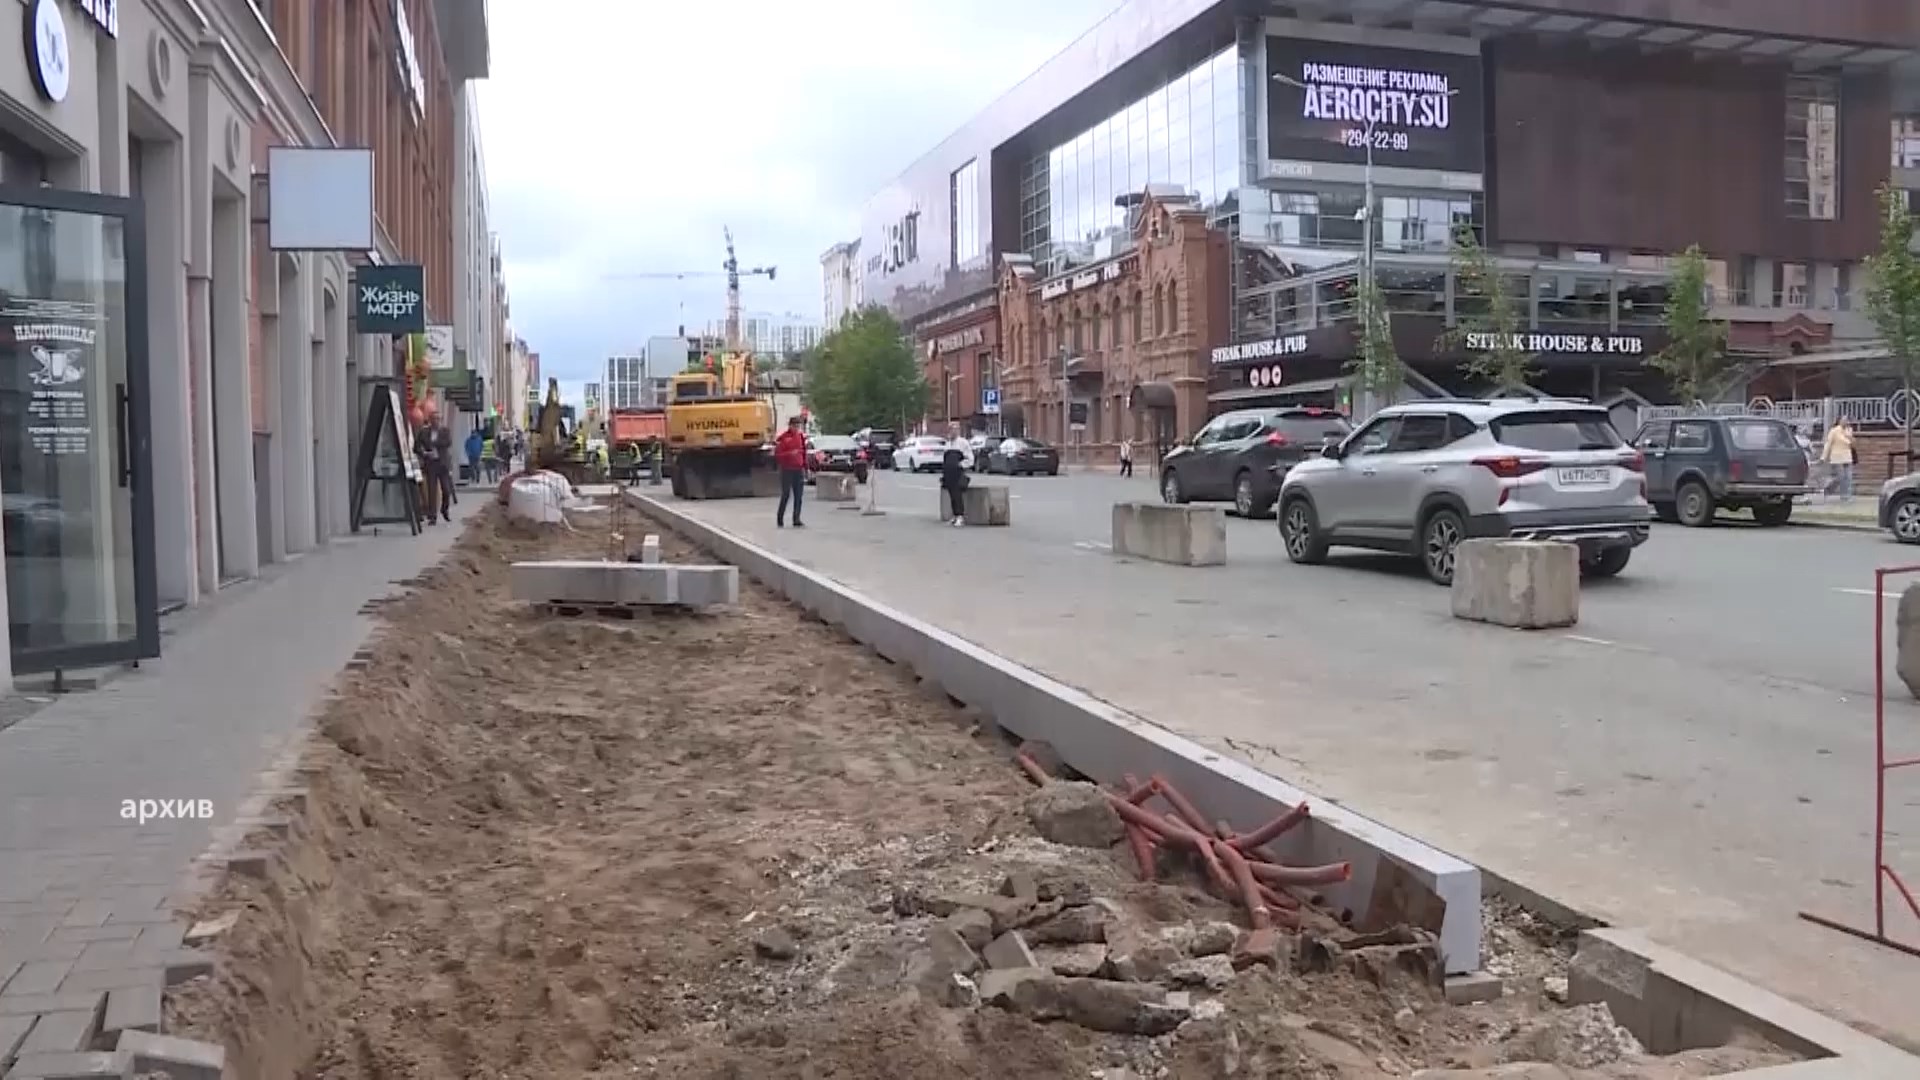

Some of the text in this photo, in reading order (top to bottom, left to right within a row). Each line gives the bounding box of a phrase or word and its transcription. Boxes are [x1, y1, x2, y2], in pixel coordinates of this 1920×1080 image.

[1303, 63, 1448, 93] РАЗМЕЩЕНИЕ РЕКЛАМЫ
[1303, 83, 1449, 128] AEROCITY.SU
[361, 286, 420, 302] Жизнь
[367, 303, 416, 320] март
[1212, 335, 1307, 364] STEAK HOUSE & PUB
[1528, 334, 1588, 352] HOUSE
[1590, 337, 1604, 352] &
[1607, 337, 1642, 353] PUB
[686, 419, 740, 431] HYUNDAI
